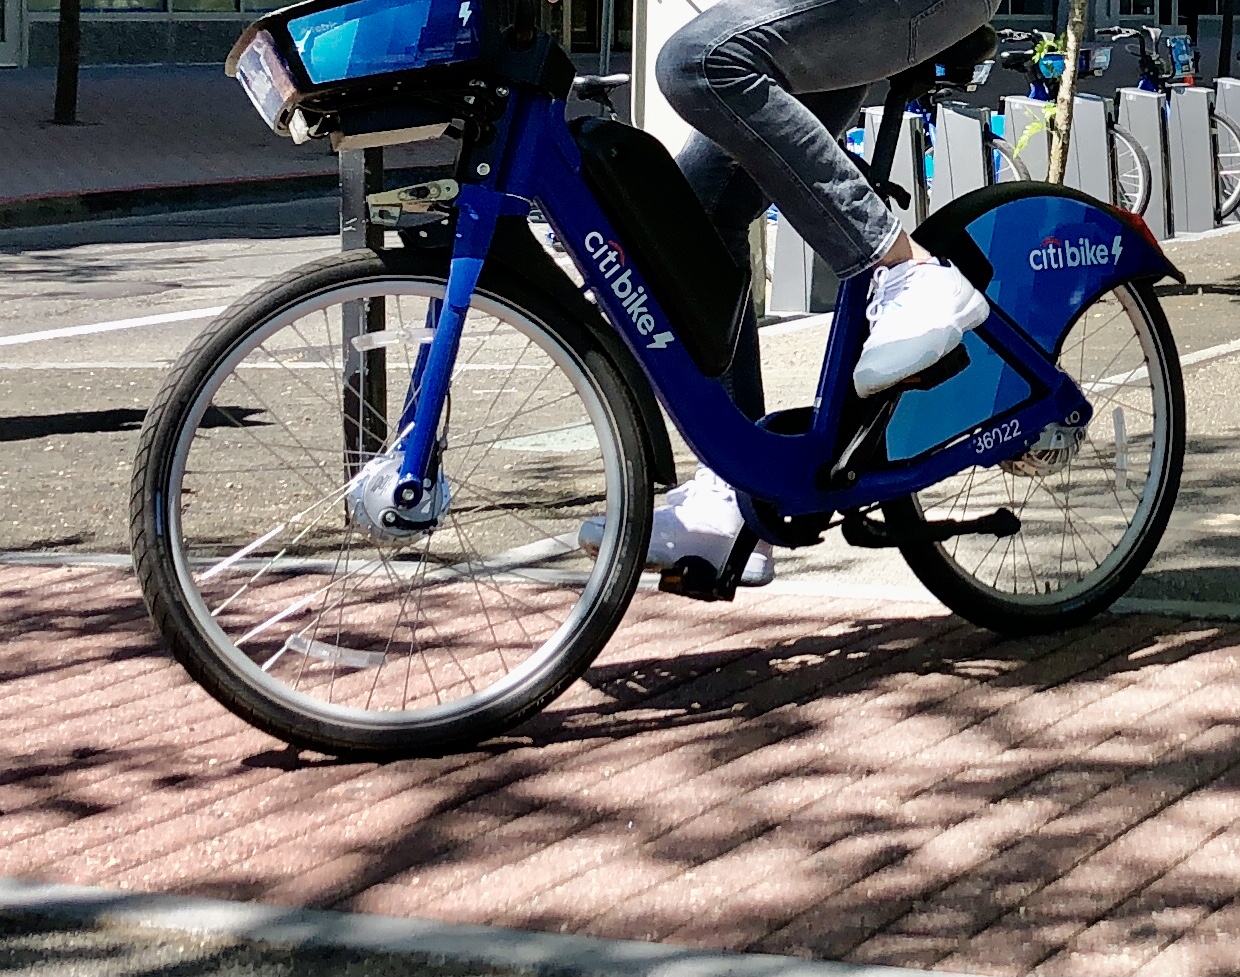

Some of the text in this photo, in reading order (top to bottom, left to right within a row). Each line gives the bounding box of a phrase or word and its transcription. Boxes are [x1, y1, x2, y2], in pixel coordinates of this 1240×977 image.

[584, 231, 655, 336] citi bike
[1029, 237, 1109, 271] citi bike
